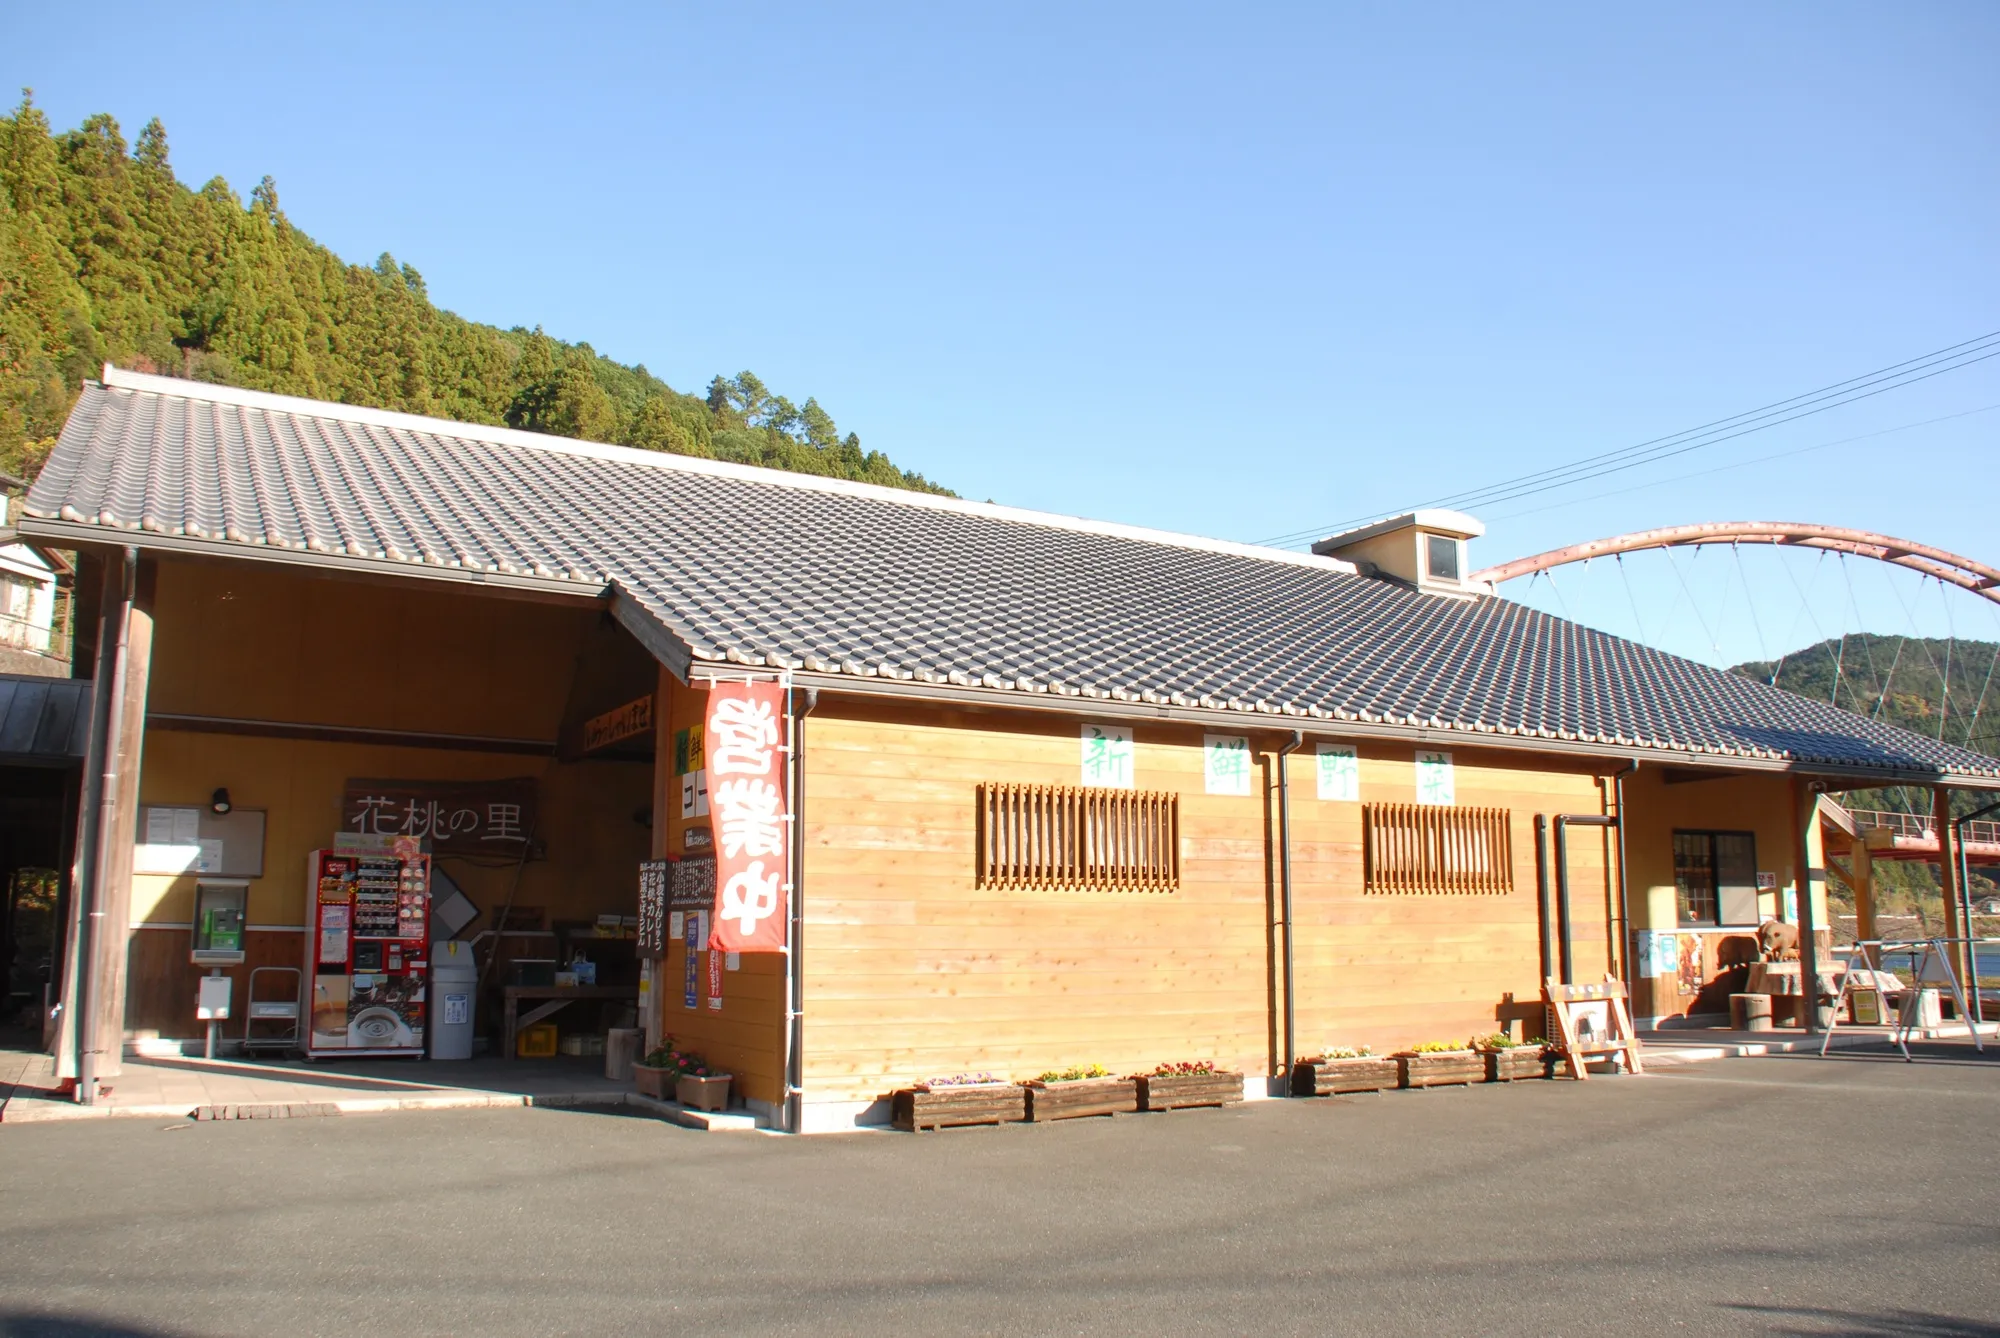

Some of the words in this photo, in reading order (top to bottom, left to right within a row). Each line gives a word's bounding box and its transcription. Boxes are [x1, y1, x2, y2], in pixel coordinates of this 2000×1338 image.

[351, 795, 527, 840] 花桃の里
[710, 697, 783, 936] 営業中
